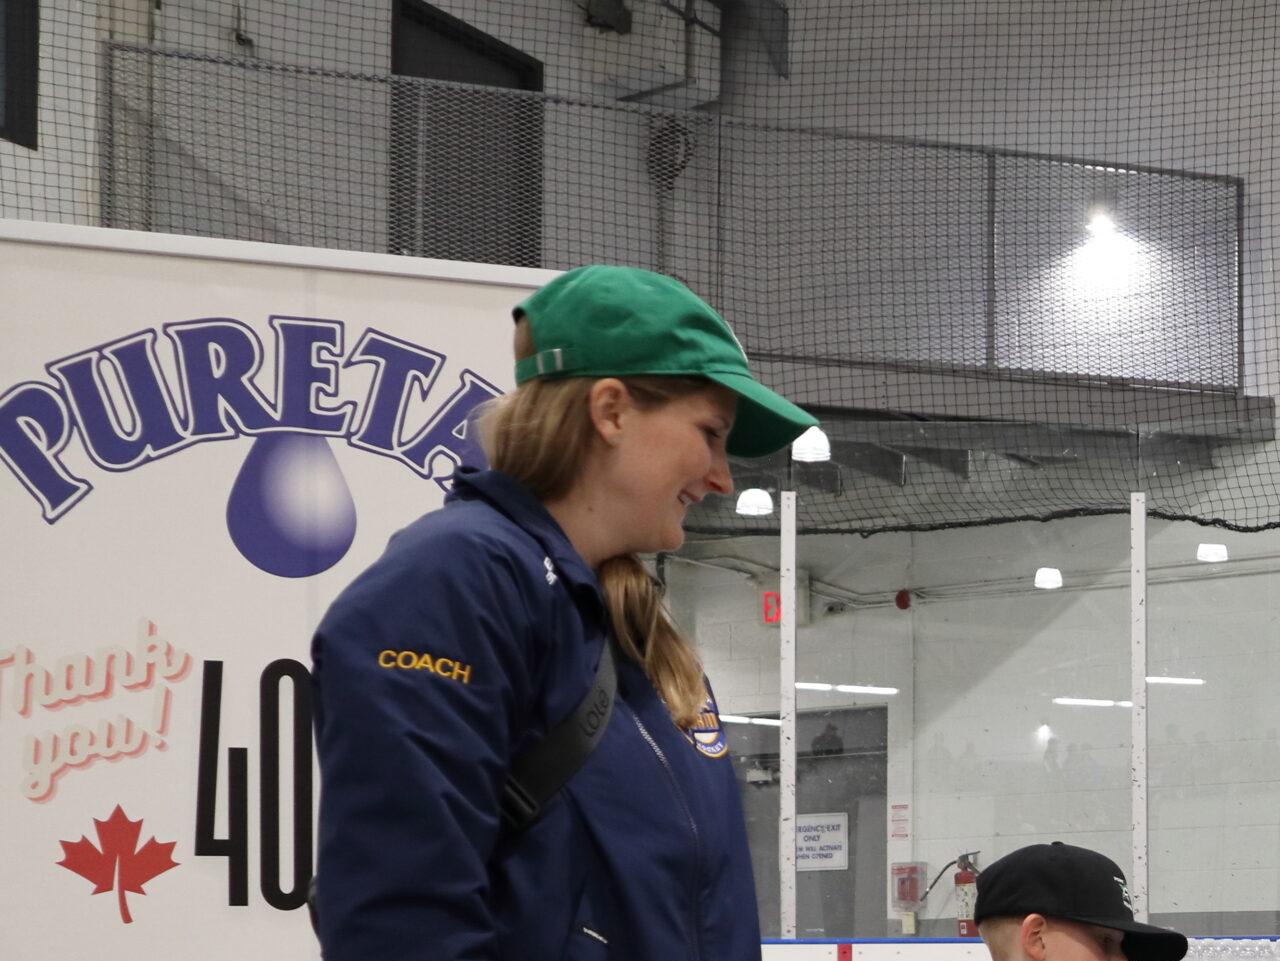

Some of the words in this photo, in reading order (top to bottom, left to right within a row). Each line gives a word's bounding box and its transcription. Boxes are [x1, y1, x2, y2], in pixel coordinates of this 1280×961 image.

[377, 649, 472, 684] COACH
[20, 683, 173, 805] you!
[195, 658, 313, 911] 40
